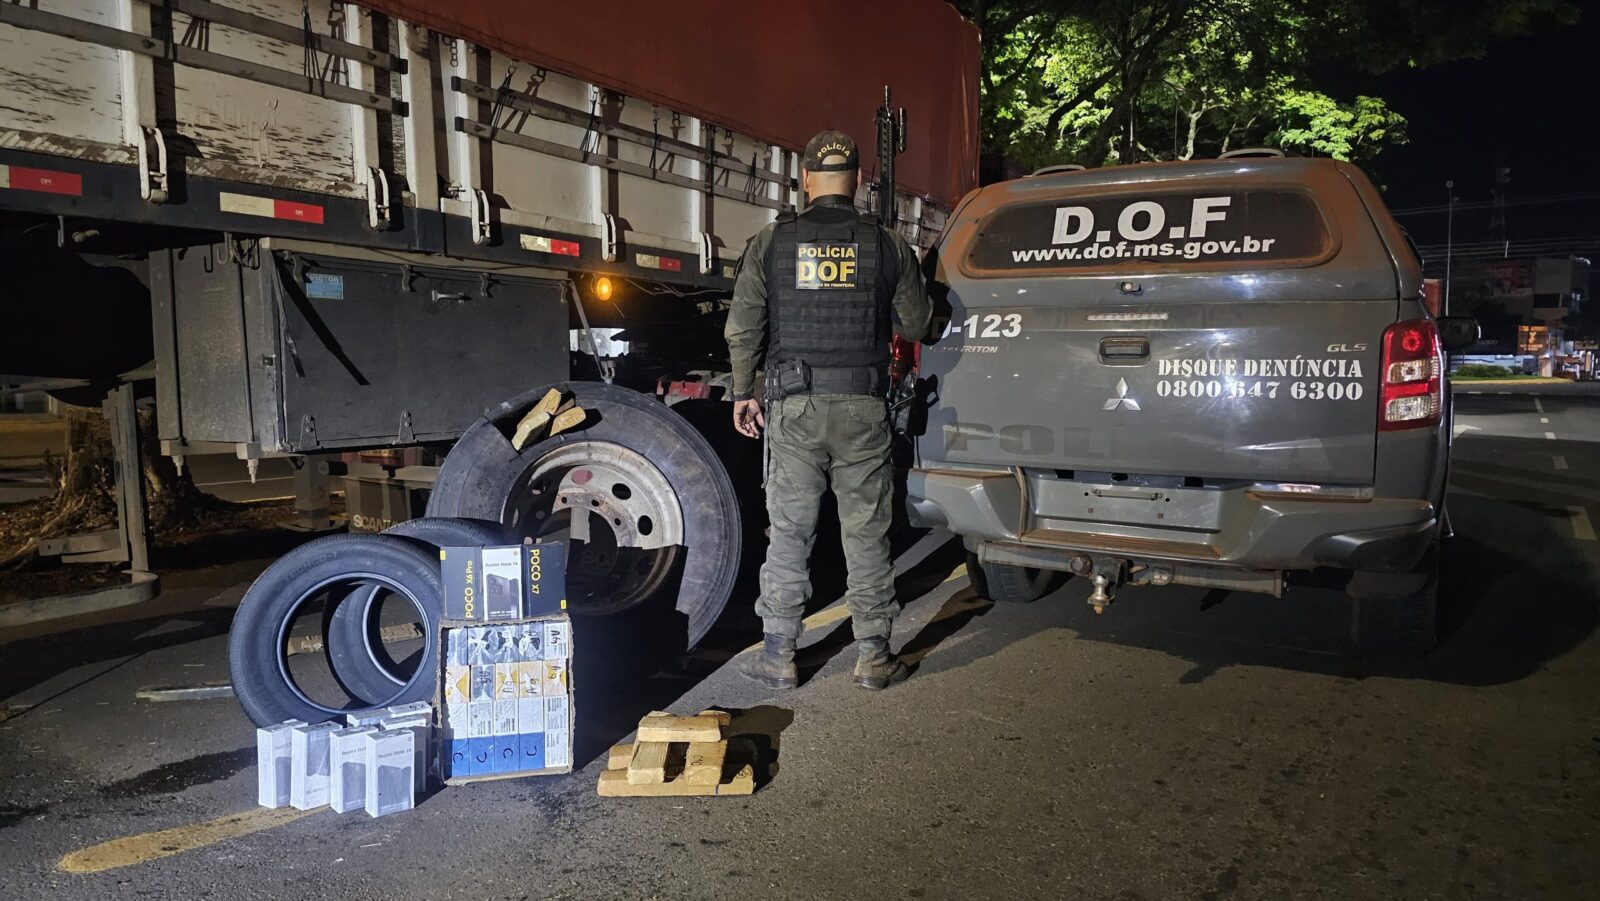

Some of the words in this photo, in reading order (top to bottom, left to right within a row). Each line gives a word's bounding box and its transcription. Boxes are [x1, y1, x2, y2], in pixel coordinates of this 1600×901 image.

[817, 142, 850, 158] POLÍCIA
[1052, 197, 1231, 245] D.O.F
[798, 245, 855, 257] POLÍCIA
[1012, 236, 1275, 262] www.dof.ms.gov.br
[799, 261, 856, 282] DOF
[961, 345, 998, 353] TRITON
[1327, 343, 1368, 352] GLS
[1158, 359, 1237, 377] DISQUE
[1243, 355, 1363, 377] DENÚNCIA
[1156, 380, 1221, 398] 0800
[1228, 381, 1281, 398] 647
[1290, 381, 1363, 400] 6300
[530, 549, 540, 581] POCO
[531, 584, 540, 594] X7
[465, 587, 474, 618] POCO
